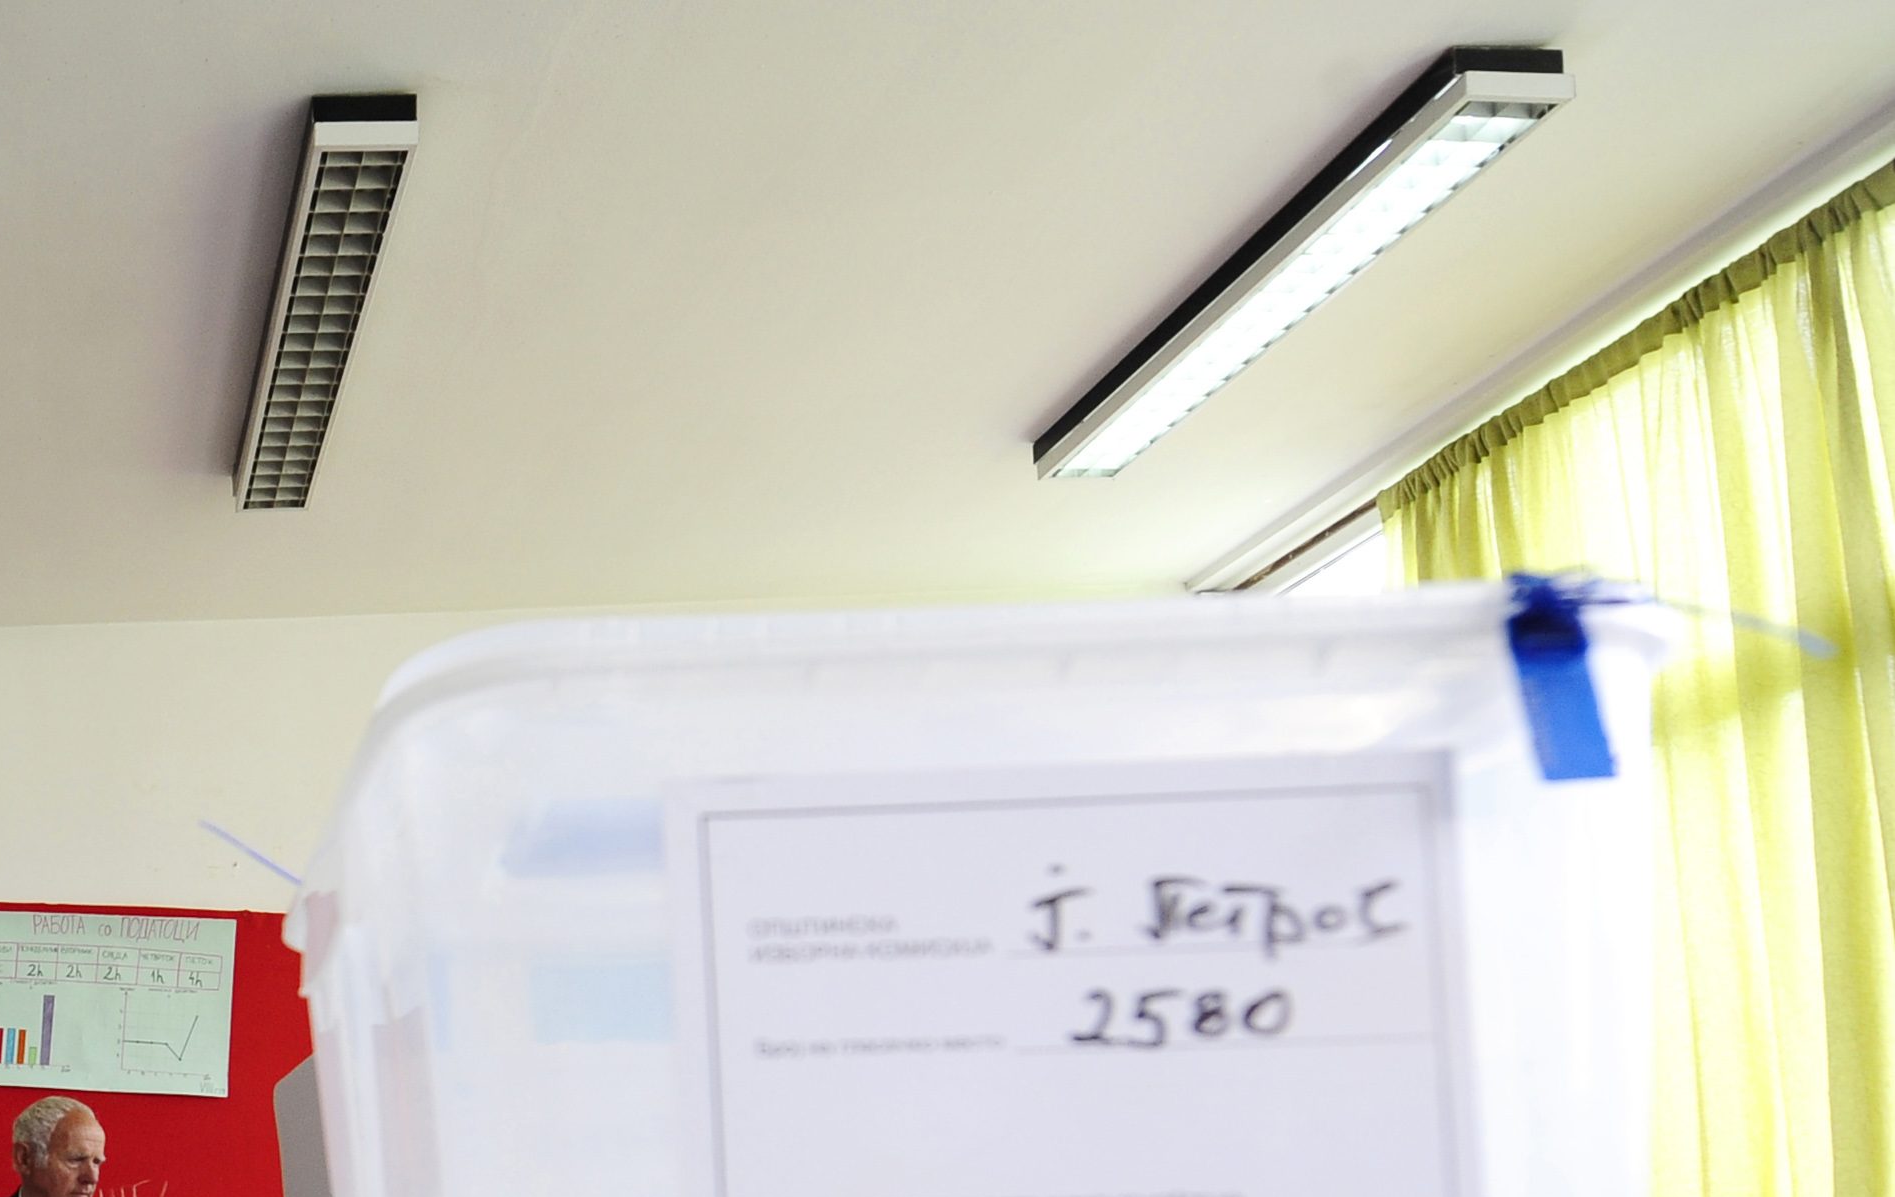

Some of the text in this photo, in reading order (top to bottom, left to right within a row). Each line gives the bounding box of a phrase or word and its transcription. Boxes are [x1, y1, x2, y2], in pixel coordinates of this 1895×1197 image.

[32, 914, 86, 936] РАБОТА
[120, 917, 201, 943] ПОДАТОЦИ
[27, 963, 44, 977] 2h
[66, 964, 82, 979] 2h
[103, 966, 121, 981] 2h
[1065, 987, 1293, 1050] 2580
